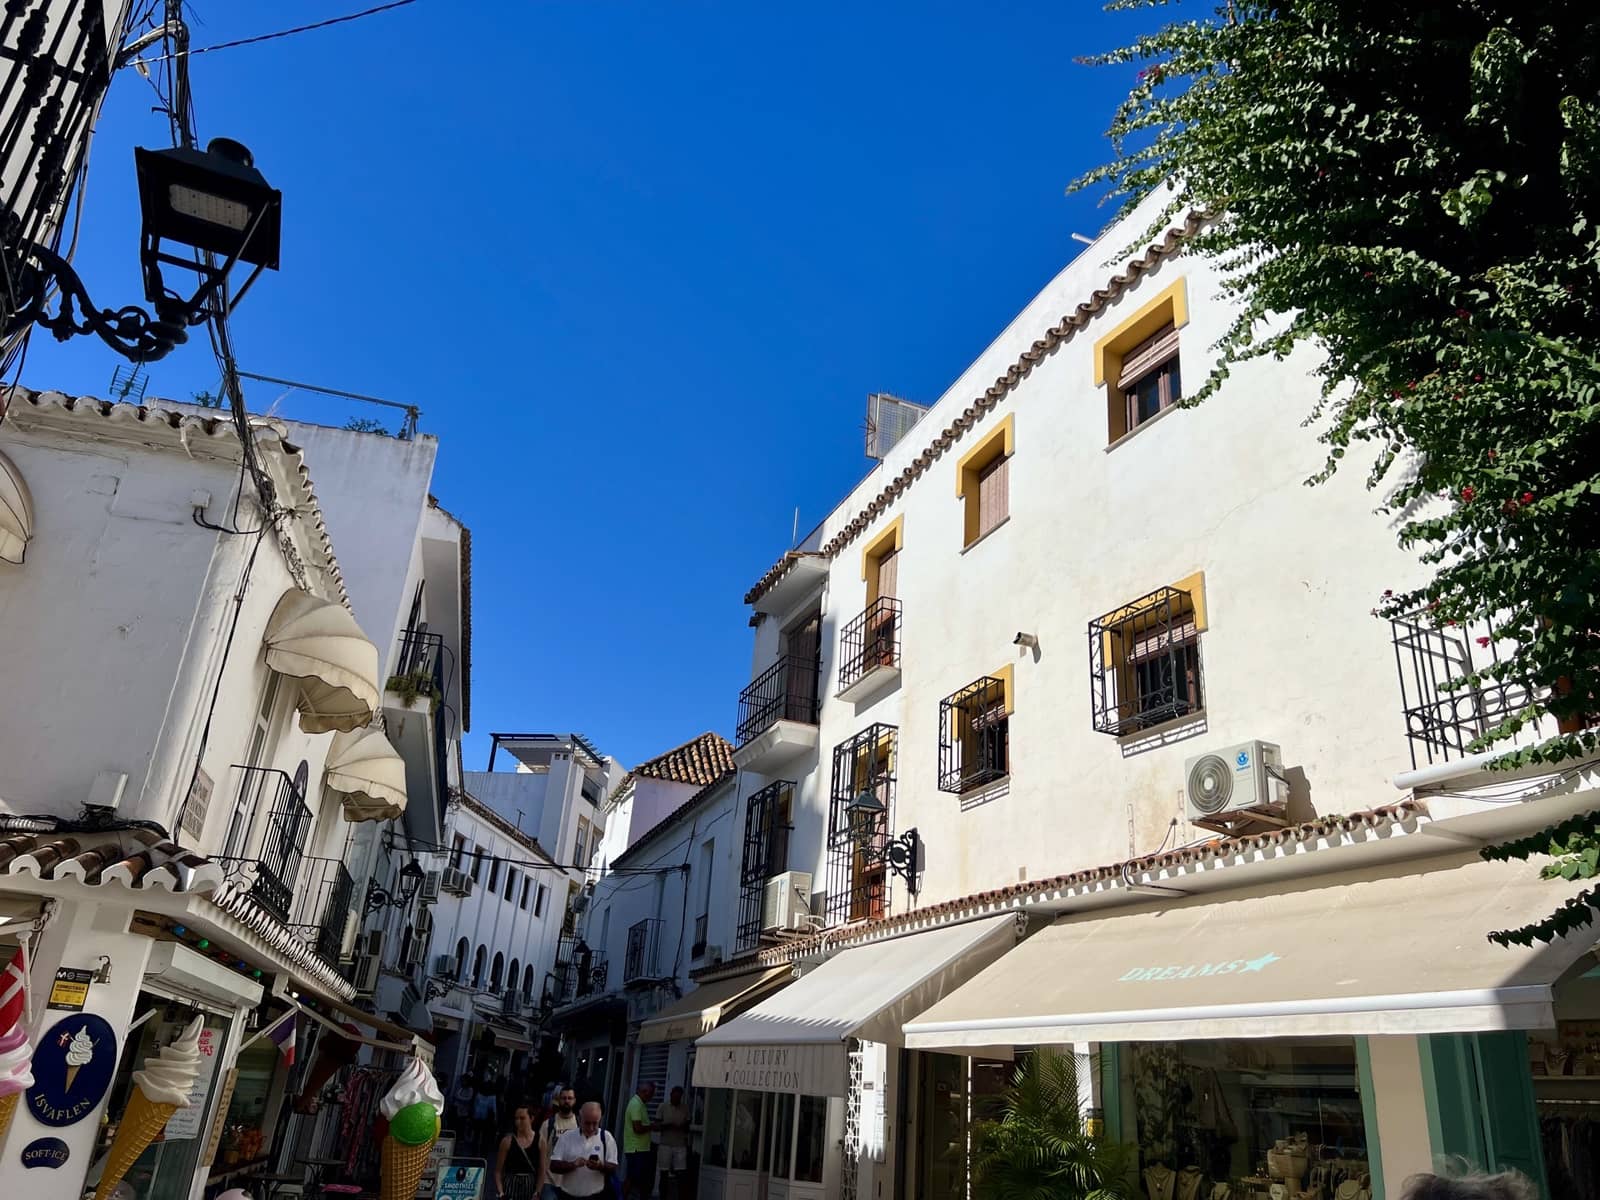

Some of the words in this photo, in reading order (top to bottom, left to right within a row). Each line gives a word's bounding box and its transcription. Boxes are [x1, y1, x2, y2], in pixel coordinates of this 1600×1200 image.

[1118, 960, 1244, 982] DREAMS
[746, 1049, 788, 1065] LUXURY
[734, 1070, 799, 1089] COLLECTION
[34, 1094, 91, 1121] ISVAFLEN
